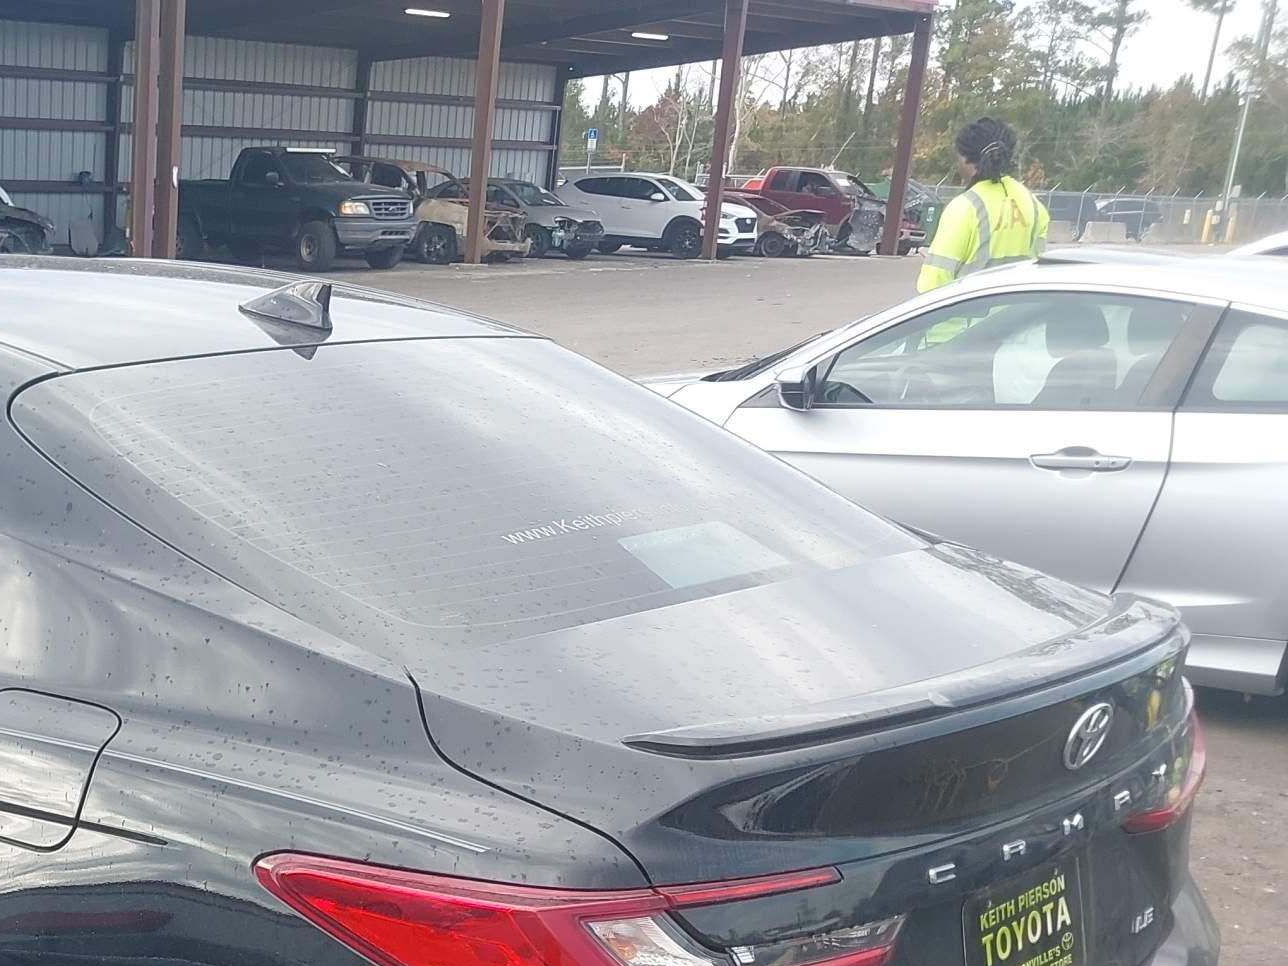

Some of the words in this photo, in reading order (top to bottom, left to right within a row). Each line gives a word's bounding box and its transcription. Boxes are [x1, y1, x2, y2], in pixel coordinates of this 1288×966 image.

[501, 508, 644, 545] www.Keithpier
[928, 763, 1167, 885] CAMRY
[979, 898, 1015, 932] KEITH
[1017, 874, 1066, 912] PIERSON
